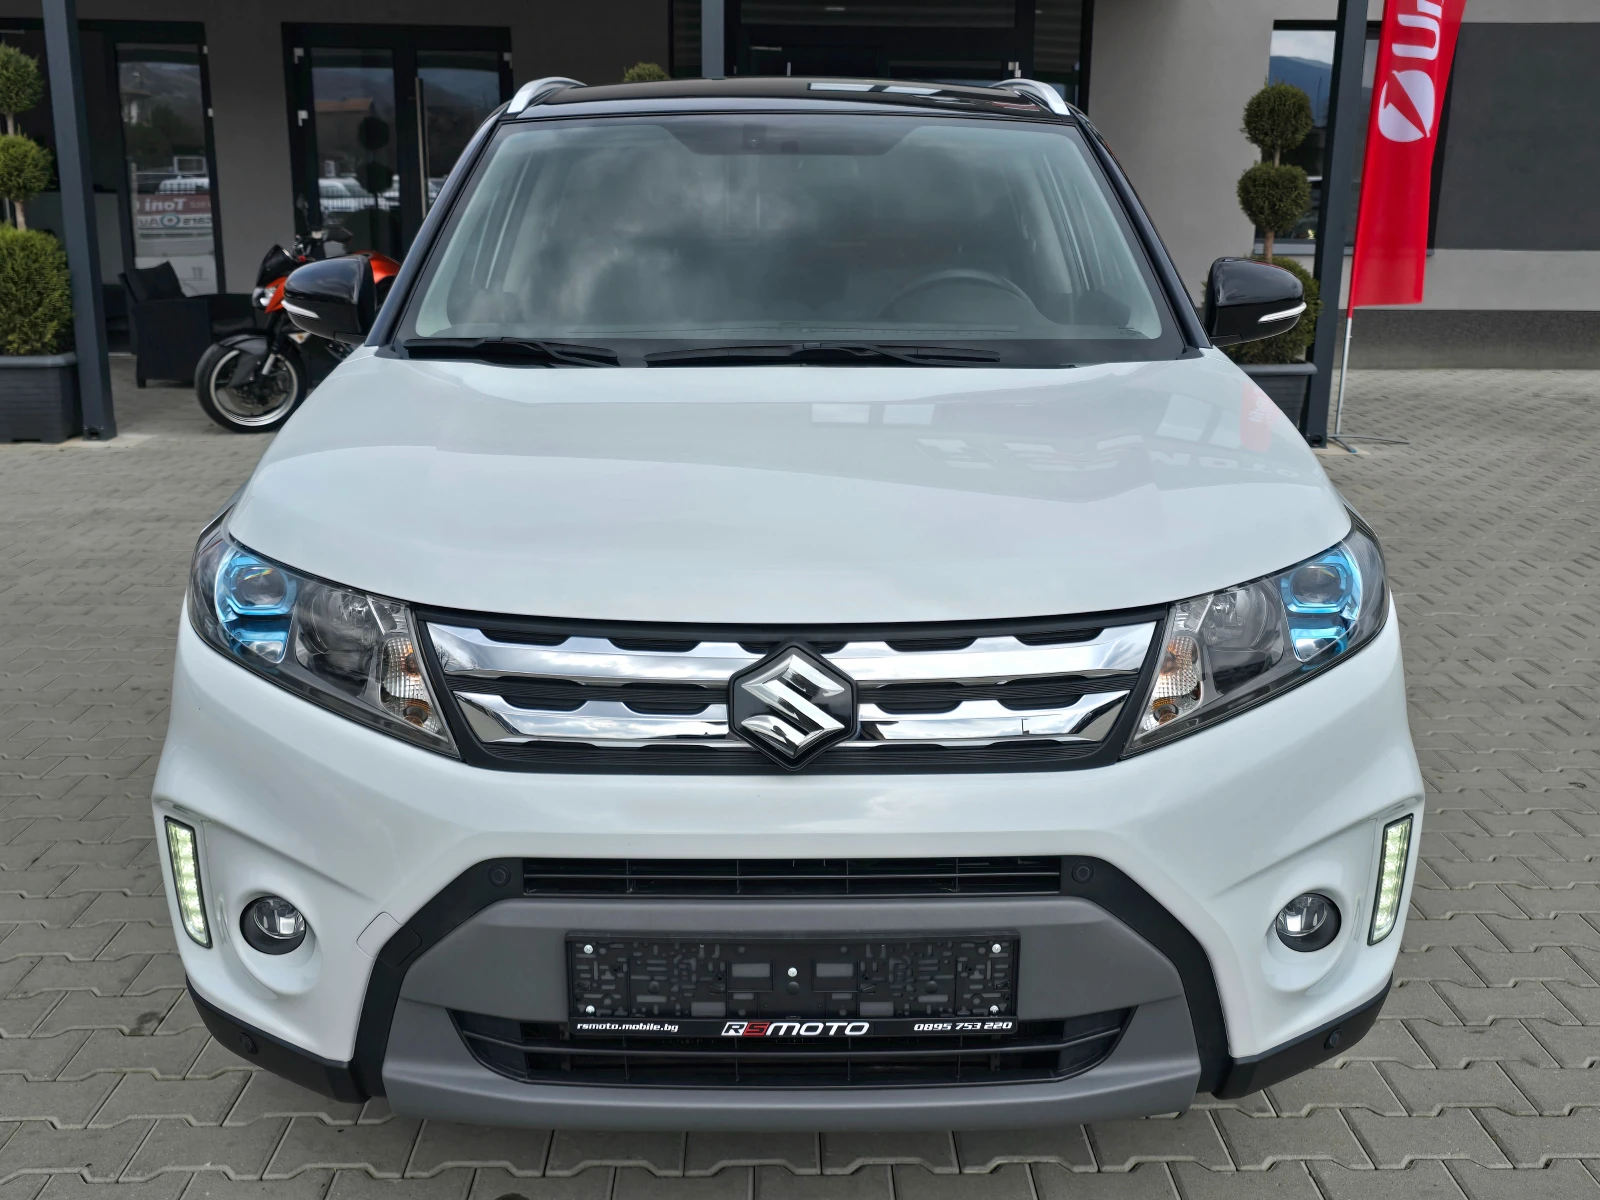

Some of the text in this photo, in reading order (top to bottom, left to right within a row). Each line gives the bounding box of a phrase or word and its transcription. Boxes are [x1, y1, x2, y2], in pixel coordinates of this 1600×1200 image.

[576, 1021, 1013, 1036] rsmoto.mobile.bg RSMOTO 0895 753 220
